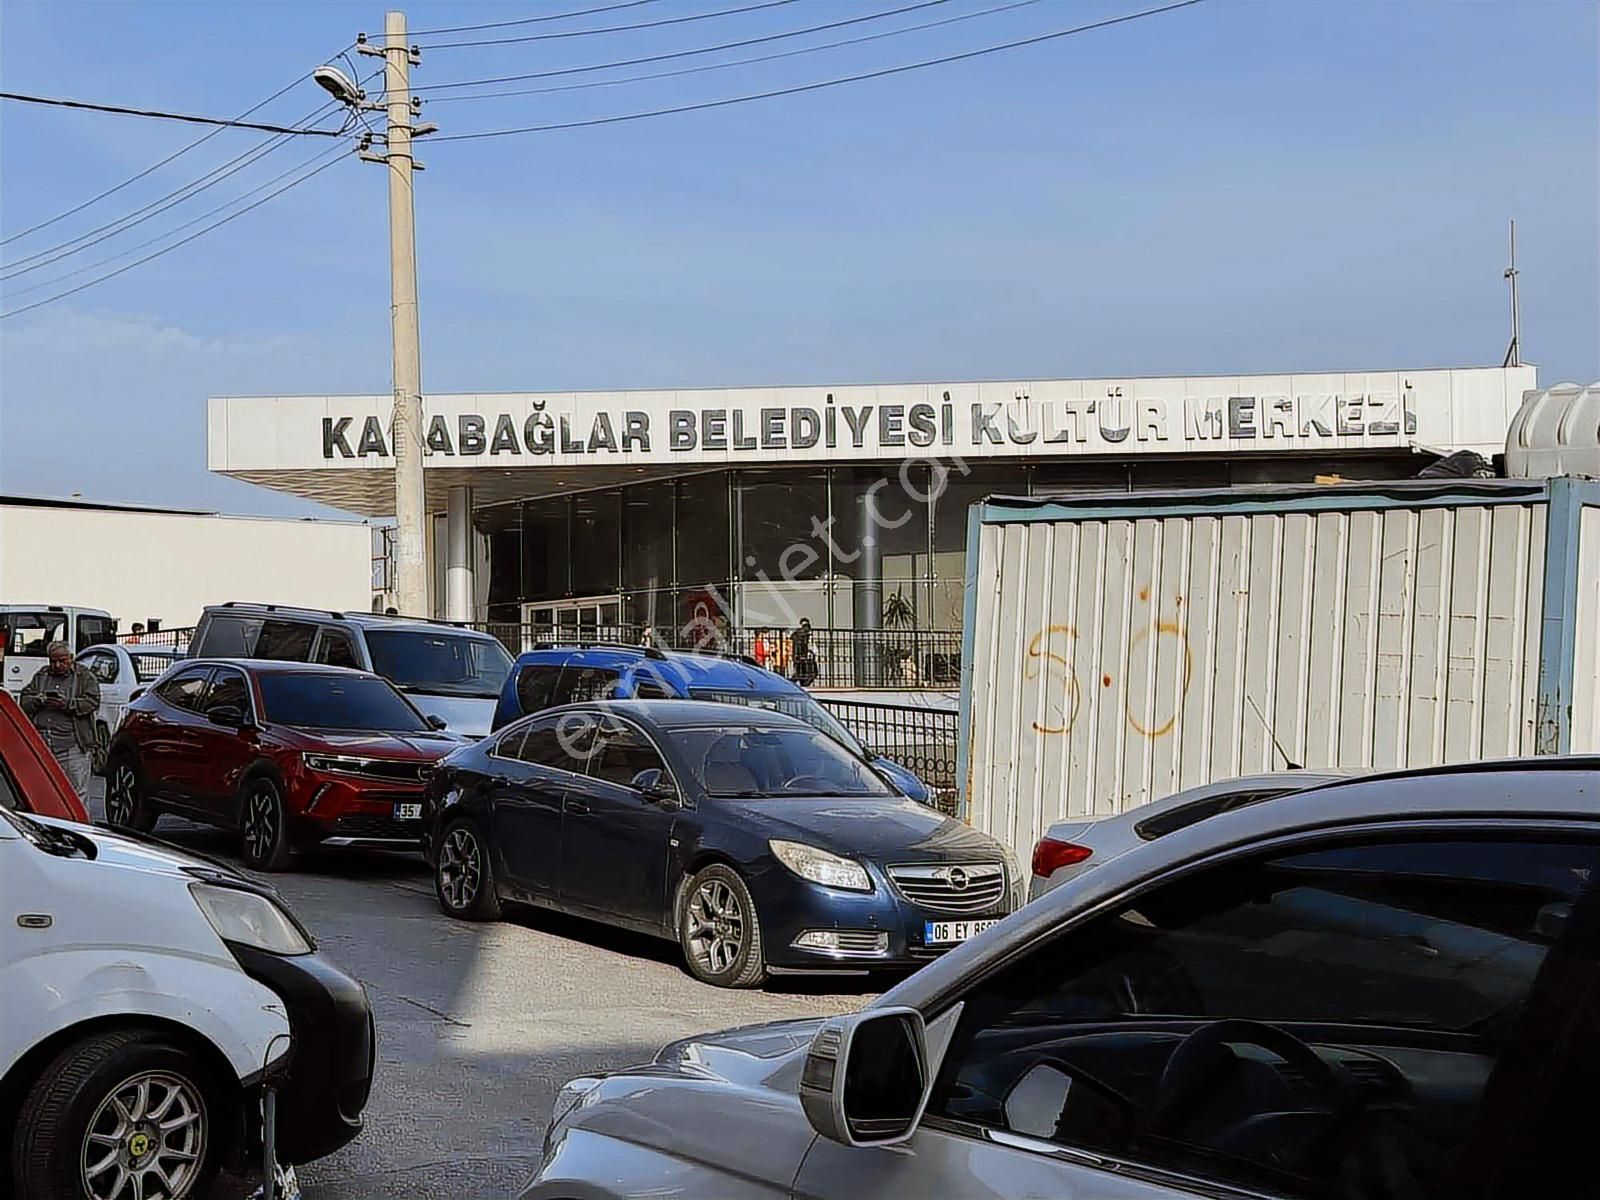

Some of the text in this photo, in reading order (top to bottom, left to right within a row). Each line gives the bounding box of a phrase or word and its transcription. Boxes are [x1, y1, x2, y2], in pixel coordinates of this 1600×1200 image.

[322, 379, 1417, 459] KAABAĞLAR BELEDİYESİ KÜLTÜR MERKEZİ
[934, 923, 949, 940] 06
[955, 922, 969, 940] EY
